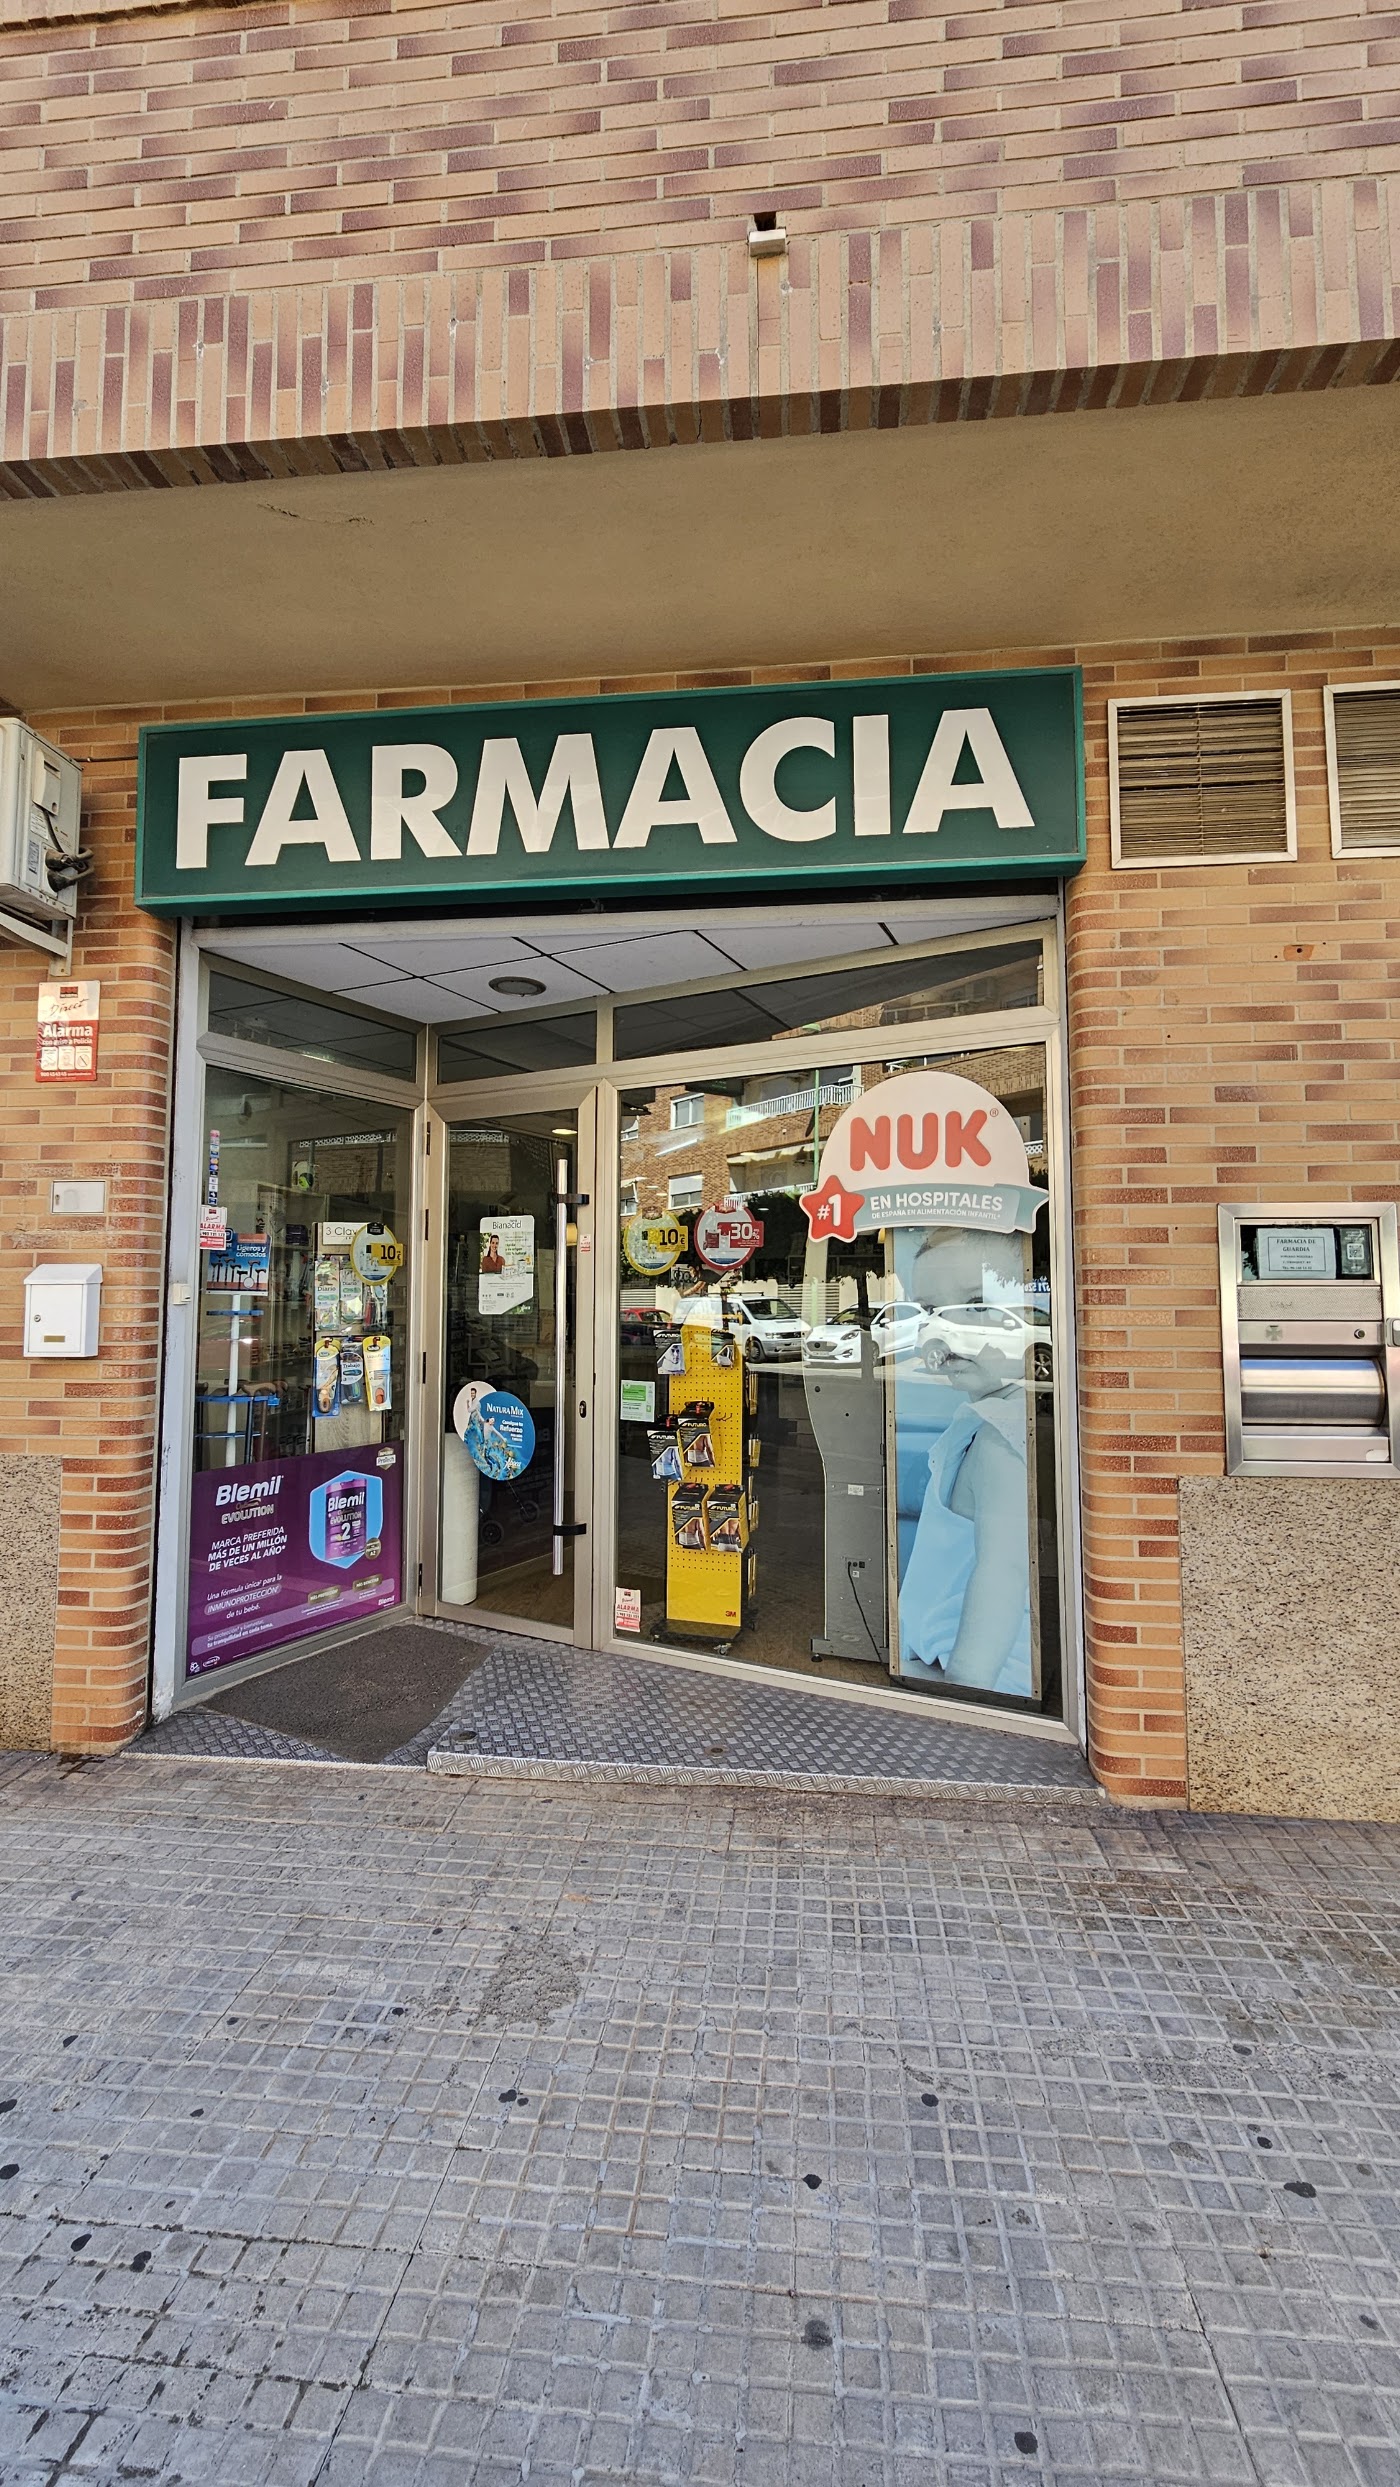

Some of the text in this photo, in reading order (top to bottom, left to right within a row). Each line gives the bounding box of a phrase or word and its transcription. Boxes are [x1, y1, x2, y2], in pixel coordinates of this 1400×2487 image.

[176, 708, 1035, 870] FARMACIA
[50, 999, 90, 1016] Direct
[43, 1024, 93, 1038] Alarma
[850, 1109, 992, 1172] NUK
[817, 1193, 841, 1227] #1
[870, 1191, 1003, 1211] EN HOSPITALES
[882, 1208, 906, 1218] ESPAÑA
[916, 1208, 966, 1216] ALIMENTACIÓN
[326, 1227, 332, 1236] 3
[492, 1220, 522, 1230] Bianacid
[660, 1229, 678, 1246] 10
[380, 1245, 396, 1260] 10
[216, 1475, 282, 1506] Blemil
[328, 1492, 365, 1512] Blemil
[222, 1504, 274, 1524] EVOLUTION
[212, 1526, 284, 1550] MARCA PREFERIDA
[341, 1522, 351, 1540] 2
[208, 1534, 288, 1562] MÁS DE UN MILLÓN
[208, 1561, 222, 1572] DE
[223, 1554, 249, 1568] VECES
[251, 1551, 262, 1560] AL
[220, 1585, 244, 1596] fórmula
[262, 1577, 276, 1586] para
[725, 1610, 736, 1618] 3M
